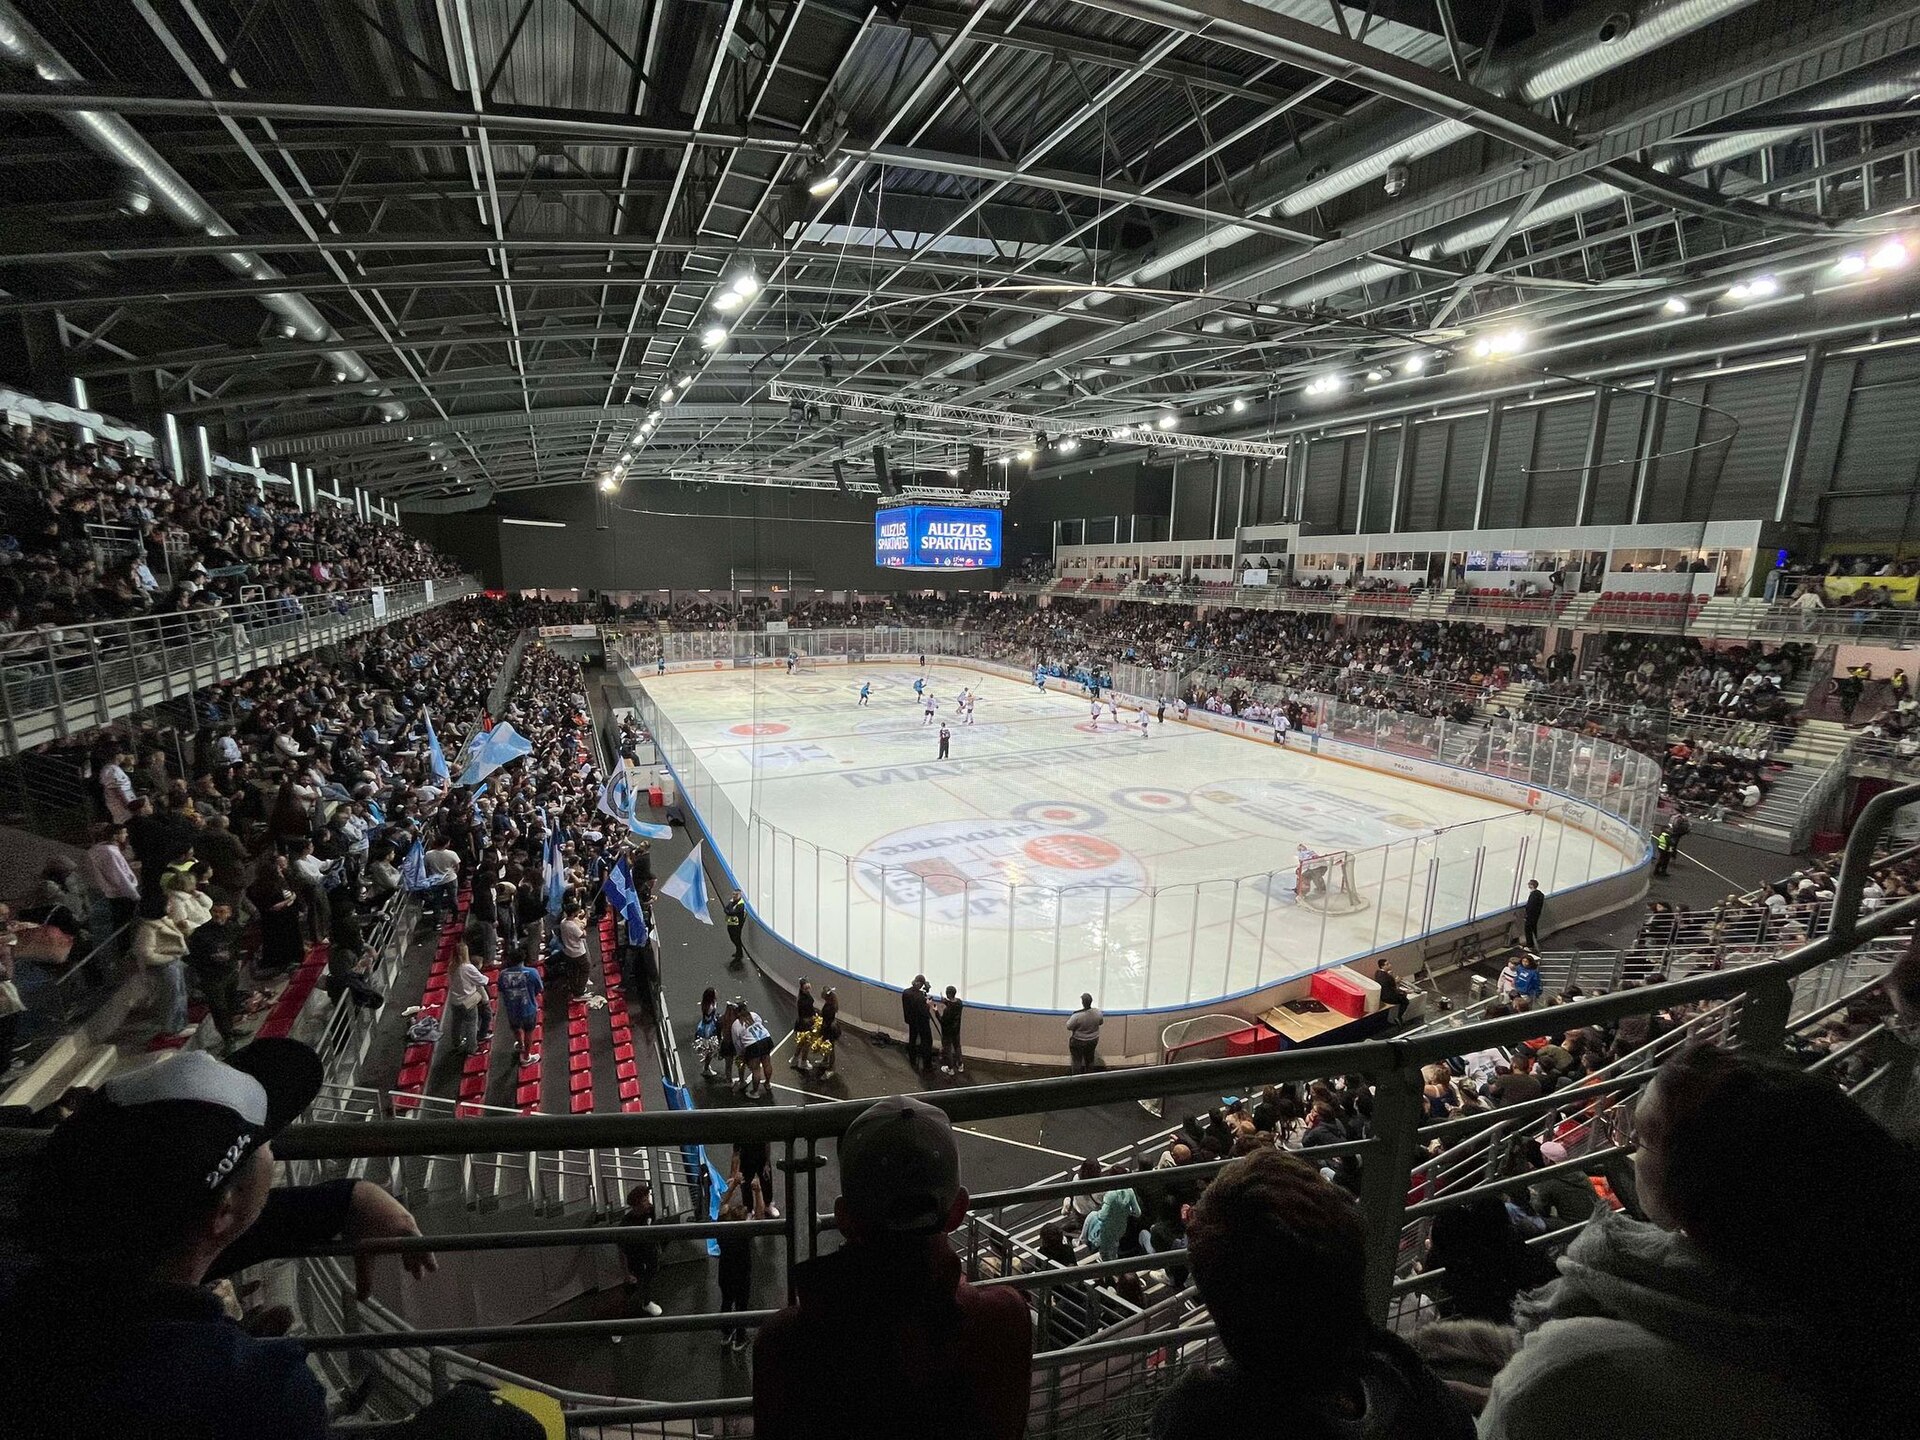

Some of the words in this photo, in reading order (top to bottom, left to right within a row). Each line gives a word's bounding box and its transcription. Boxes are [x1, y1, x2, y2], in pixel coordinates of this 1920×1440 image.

[880, 523, 897, 537] ALLEZ
[897, 522, 906, 536] LES
[928, 523, 966, 537] ALLEZ
[966, 523, 987, 537] LES
[878, 536, 909, 550] SPARTIATES
[921, 536, 992, 551] SPARTIATES
[1394, 762, 1414, 772] PRADO
[205, 1134, 251, 1190] 2024
